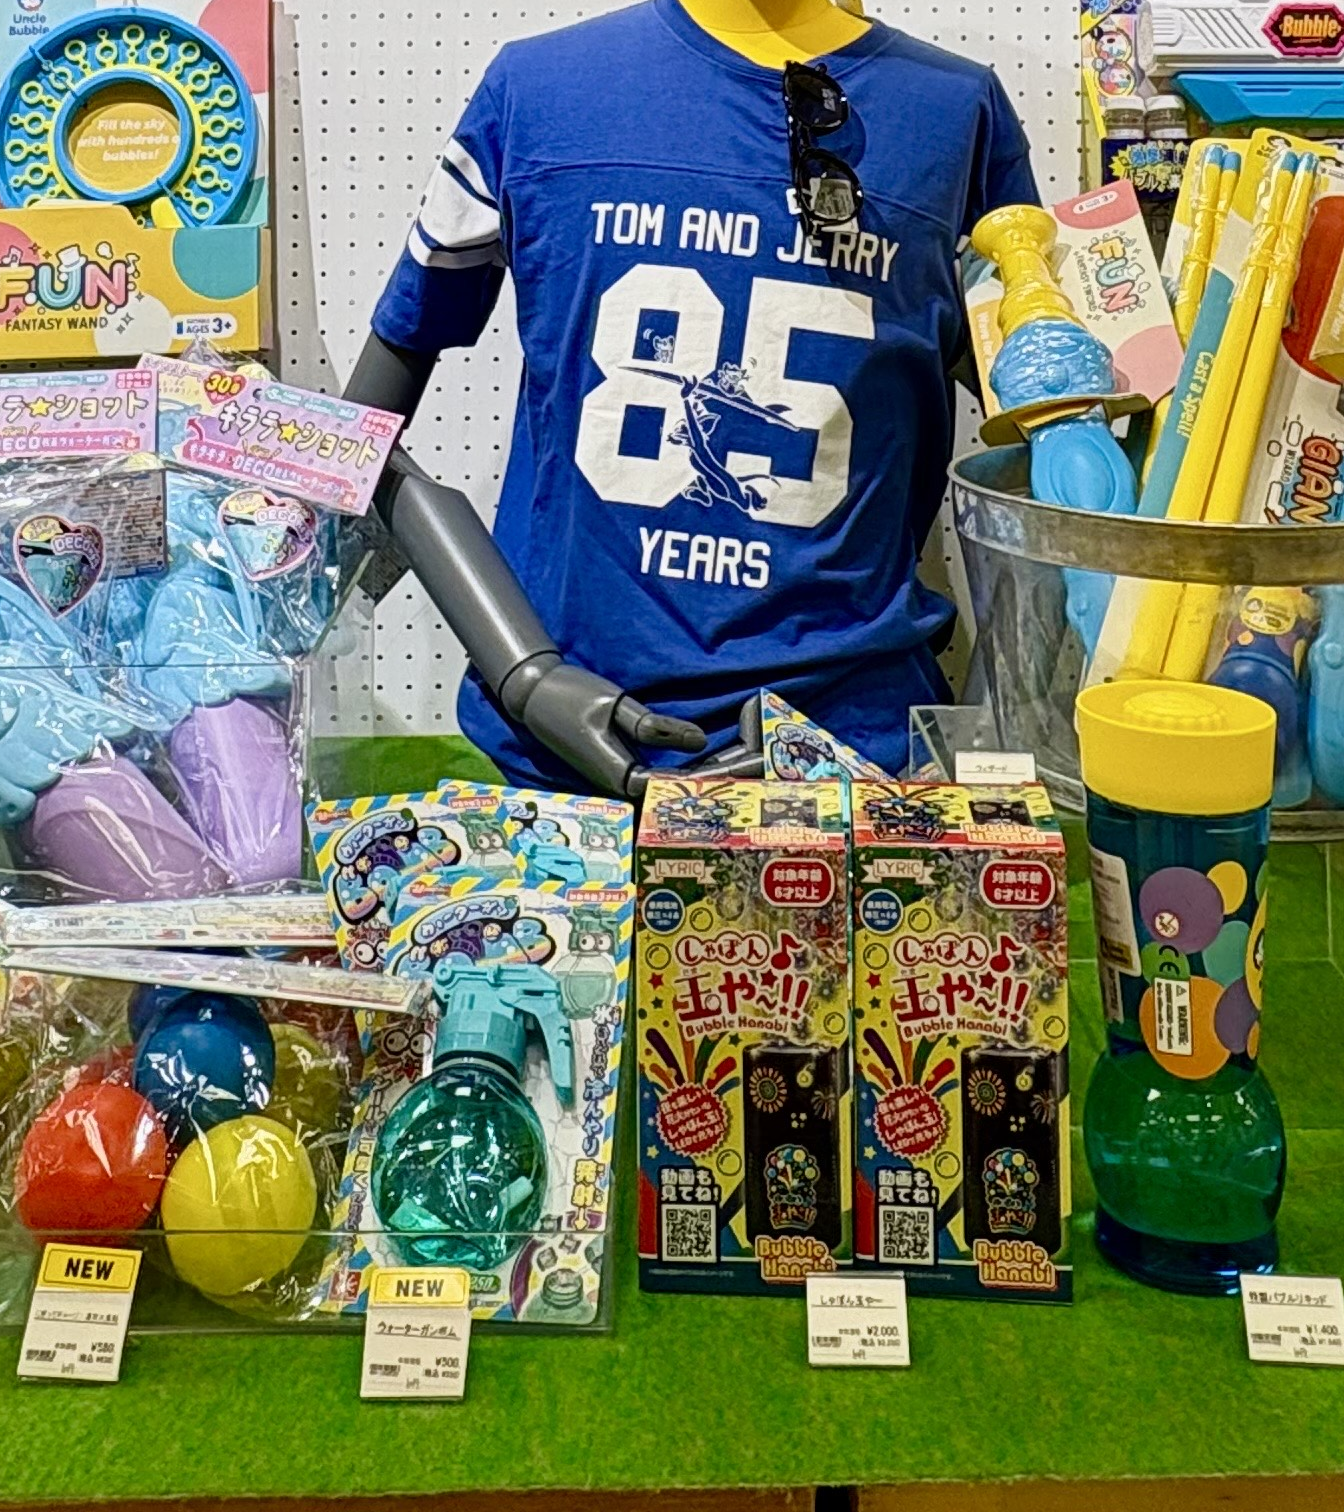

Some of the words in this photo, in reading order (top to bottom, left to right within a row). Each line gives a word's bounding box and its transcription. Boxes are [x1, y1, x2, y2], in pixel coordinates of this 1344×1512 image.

[12, 13, 47, 24] Uncle
[1281, 13, 1339, 39] Bubble
[8, 25, 50, 36] Bubble
[121, 119, 141, 131] the
[143, 119, 166, 134] sky
[106, 134, 168, 147] hundreds
[590, 202, 665, 247] TOM
[678, 207, 760, 257] AND
[776, 219, 901, 283] JERRY
[1088, 235, 1140, 314] FUN
[5, 316, 63, 332] FANTASY
[67, 315, 108, 330] WAND
[185, 324, 210, 335] AGES
[212, 318, 233, 334] 3+
[574, 263, 878, 530] 85
[636, 526, 772, 589] YEARS
[658, 861, 703, 877] LYRIC
[772, 868, 823, 883] 対象年齢
[874, 861, 923, 876] LYRIC
[992, 871, 1044, 886] 対象年齢
[683, 938, 765, 963] しゃぼん
[902, 940, 985, 965] しゃぼん
[685, 1017, 736, 1036] Bubble
[738, 1016, 789, 1034] Hanabi
[904, 1019, 954, 1039] Bubble
[957, 1018, 1007, 1035] Hanabi
[661, 1168, 712, 1185] 動画も
[878, 1169, 930, 1187] 動画も
[661, 1185, 719, 1202] 見てね!
[878, 1187, 936, 1204] 見てね!
[758, 1238, 827, 1257] Bubble
[975, 1241, 1046, 1263] Bubble
[64, 1257, 115, 1282] NEW
[981, 1262, 1053, 1285] Hanabi
[395, 1279, 445, 1298] NEW
